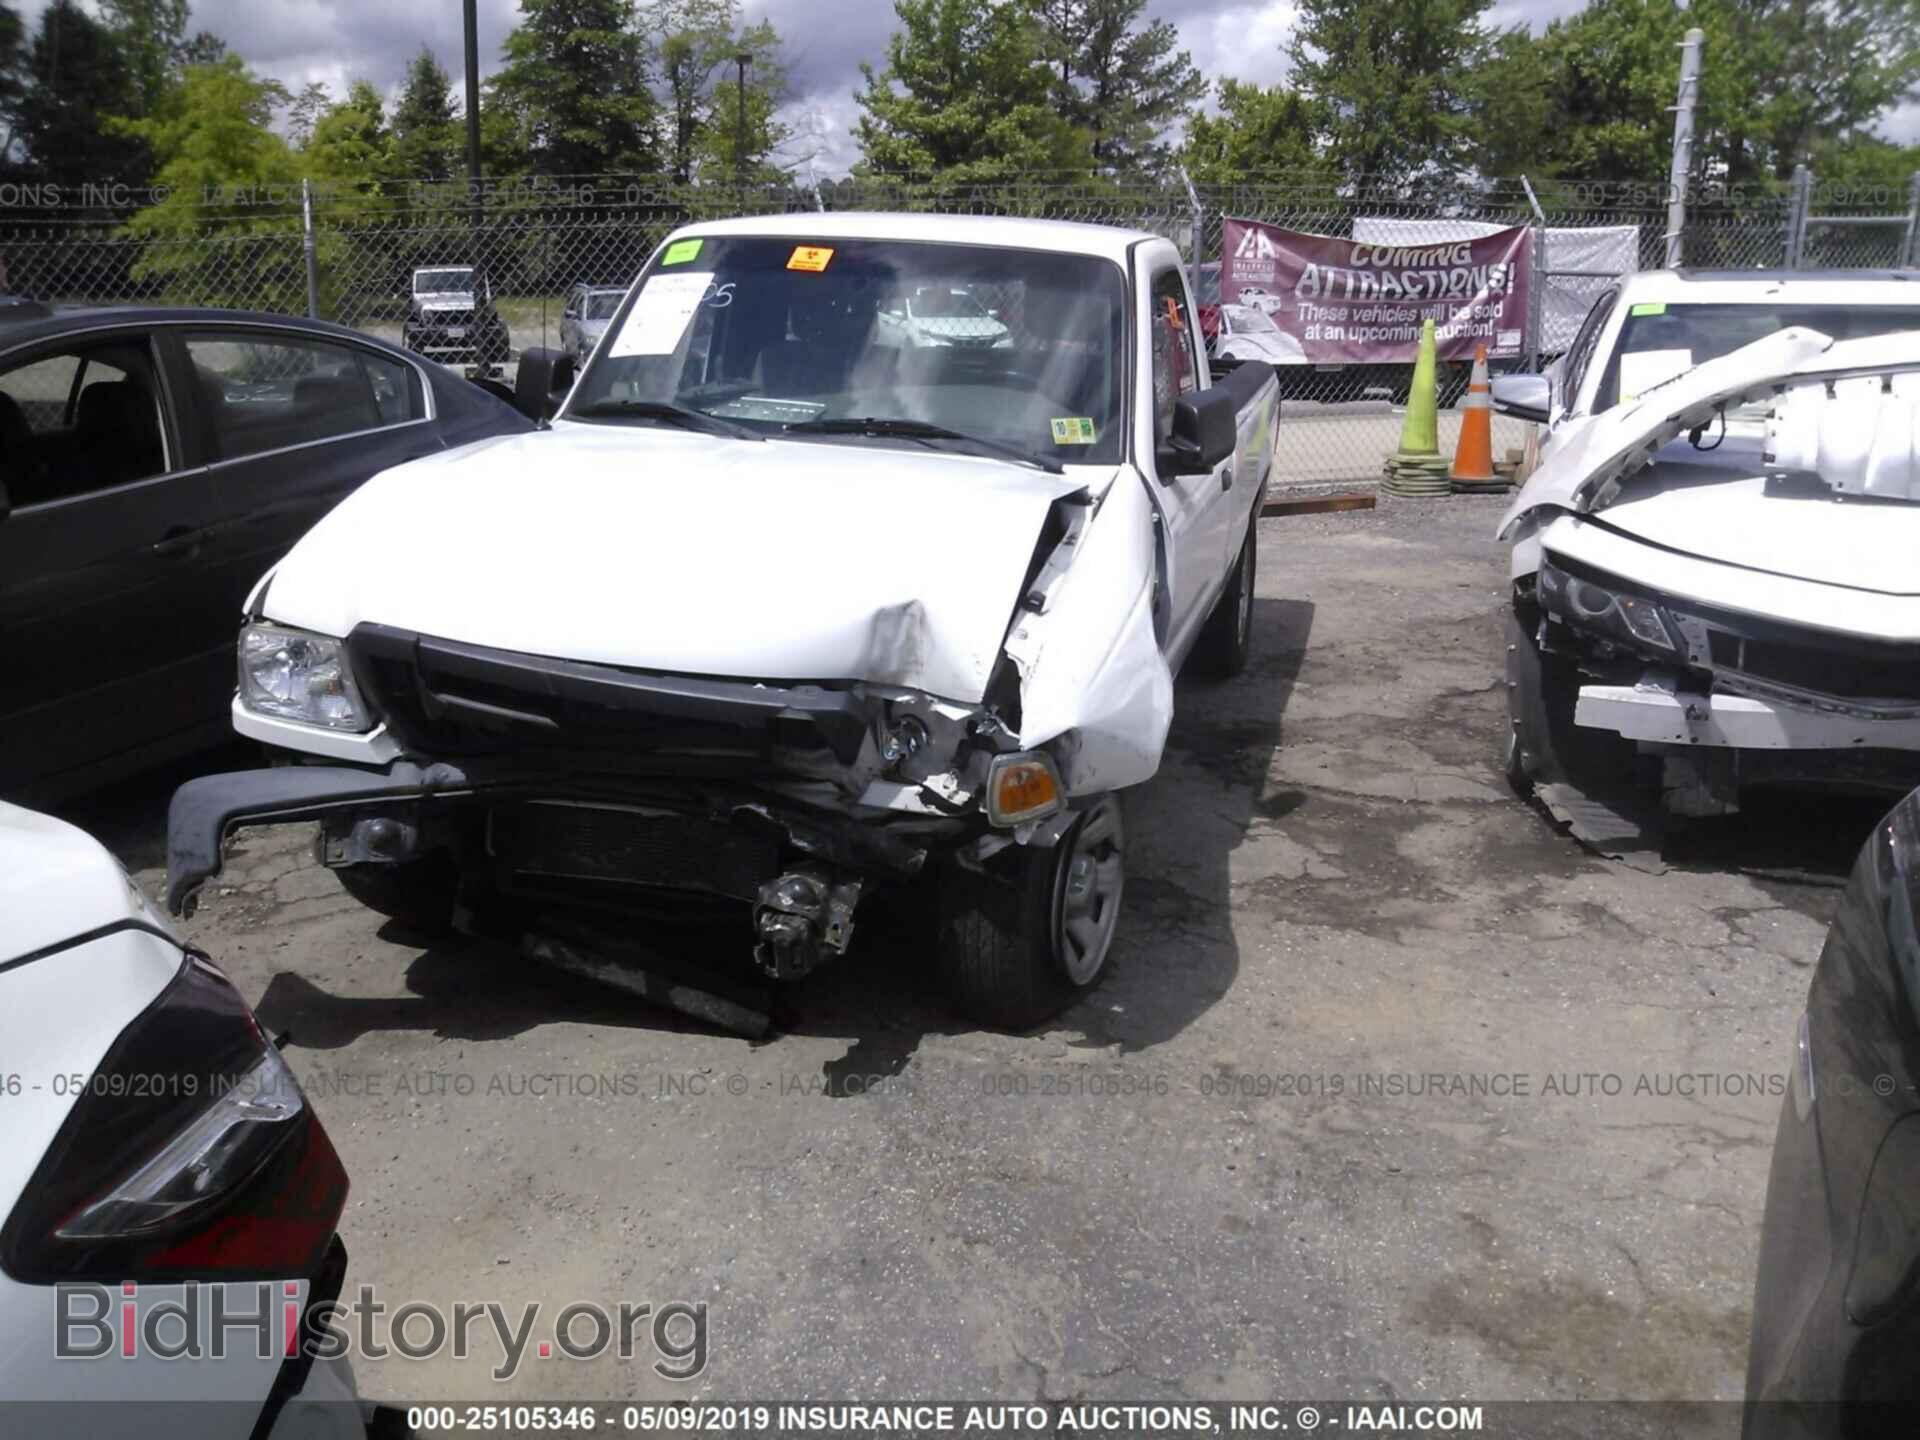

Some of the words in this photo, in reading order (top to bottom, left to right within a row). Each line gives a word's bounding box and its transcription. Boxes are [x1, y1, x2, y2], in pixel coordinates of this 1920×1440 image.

[1350, 242, 1473, 267] COMING
[1295, 262, 1516, 300] ATTRACTIONS!
[1297, 302, 1348, 321] These
[1352, 303, 1418, 322] vehicles
[1421, 303, 1445, 321] will
[1448, 302, 1472, 320] be
[1474, 300, 1504, 319] sold
[1304, 322, 1320, 340] at
[1324, 325, 1345, 340] an
